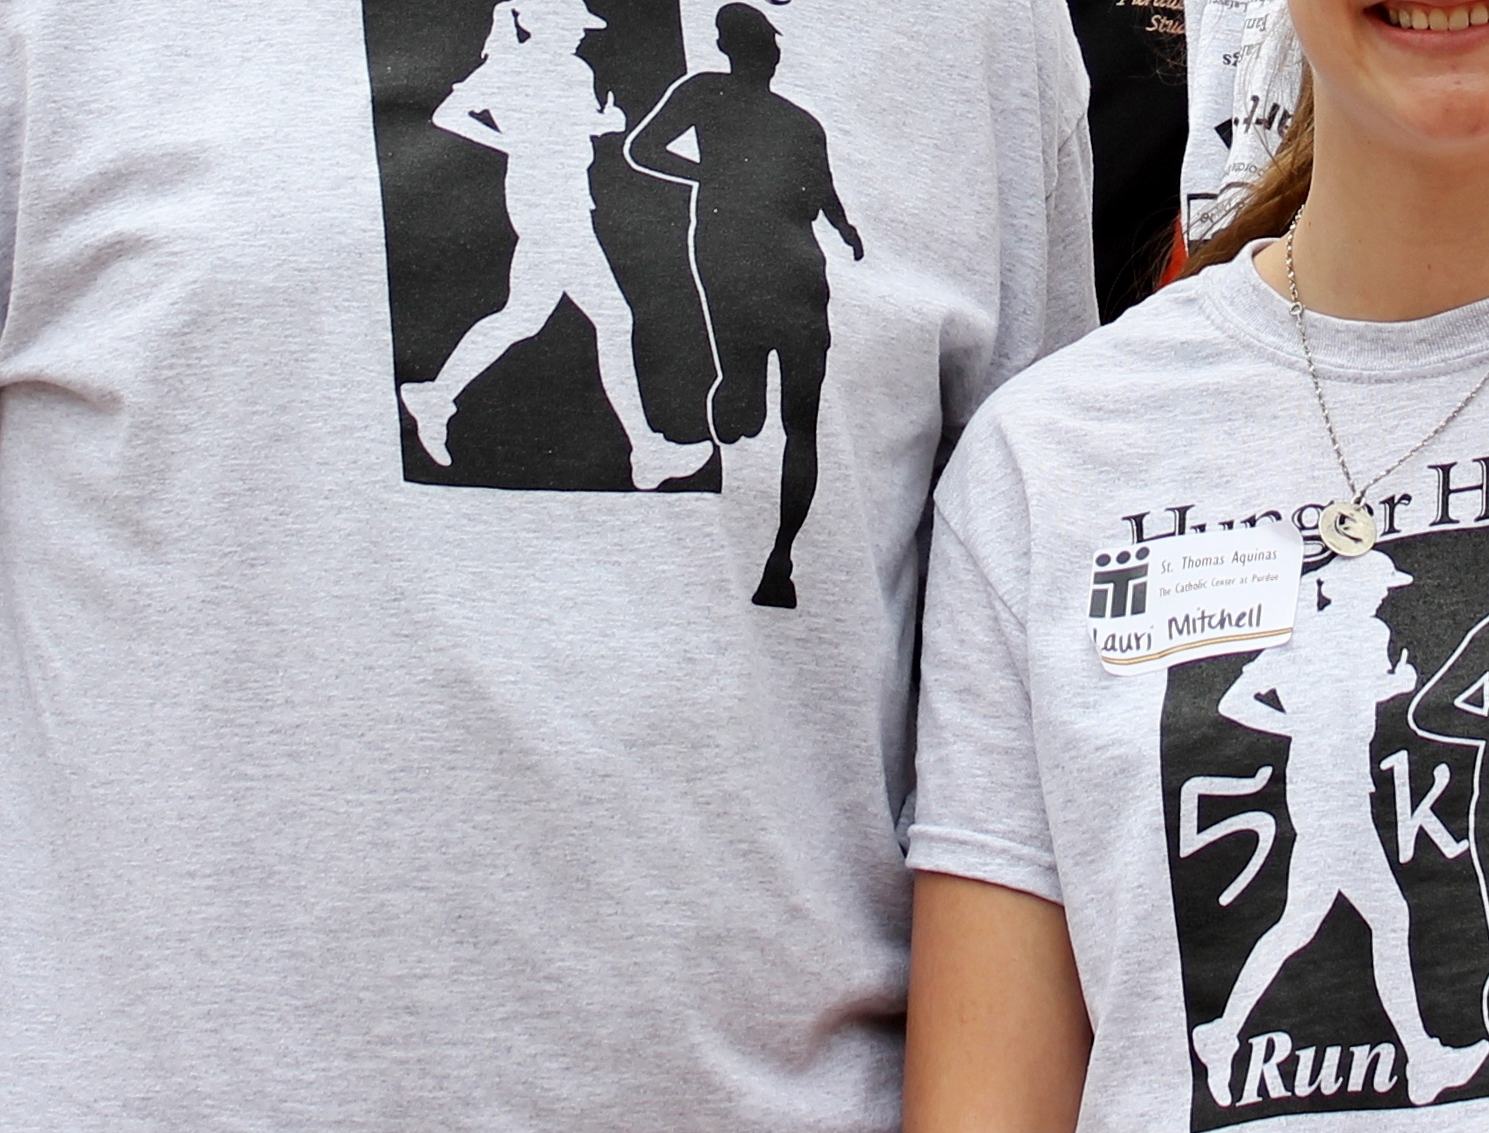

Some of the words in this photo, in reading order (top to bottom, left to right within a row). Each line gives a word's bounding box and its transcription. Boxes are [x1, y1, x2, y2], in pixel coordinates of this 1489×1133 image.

[1161, 560, 1174, 575] St.
[1182, 553, 1224, 570] Thomas
[1231, 548, 1277, 566] Aquinas
[1159, 587, 1171, 598] The
[1175, 579, 1207, 594] Catholic
[1211, 577, 1235, 587] Center
[1240, 576, 1247, 584] at
[1252, 572, 1279, 582] Purdue
[1168, 603, 1262, 640] Mitchell
[1179, 764, 1277, 908] 5
[1235, 1030, 1399, 1108] Run
